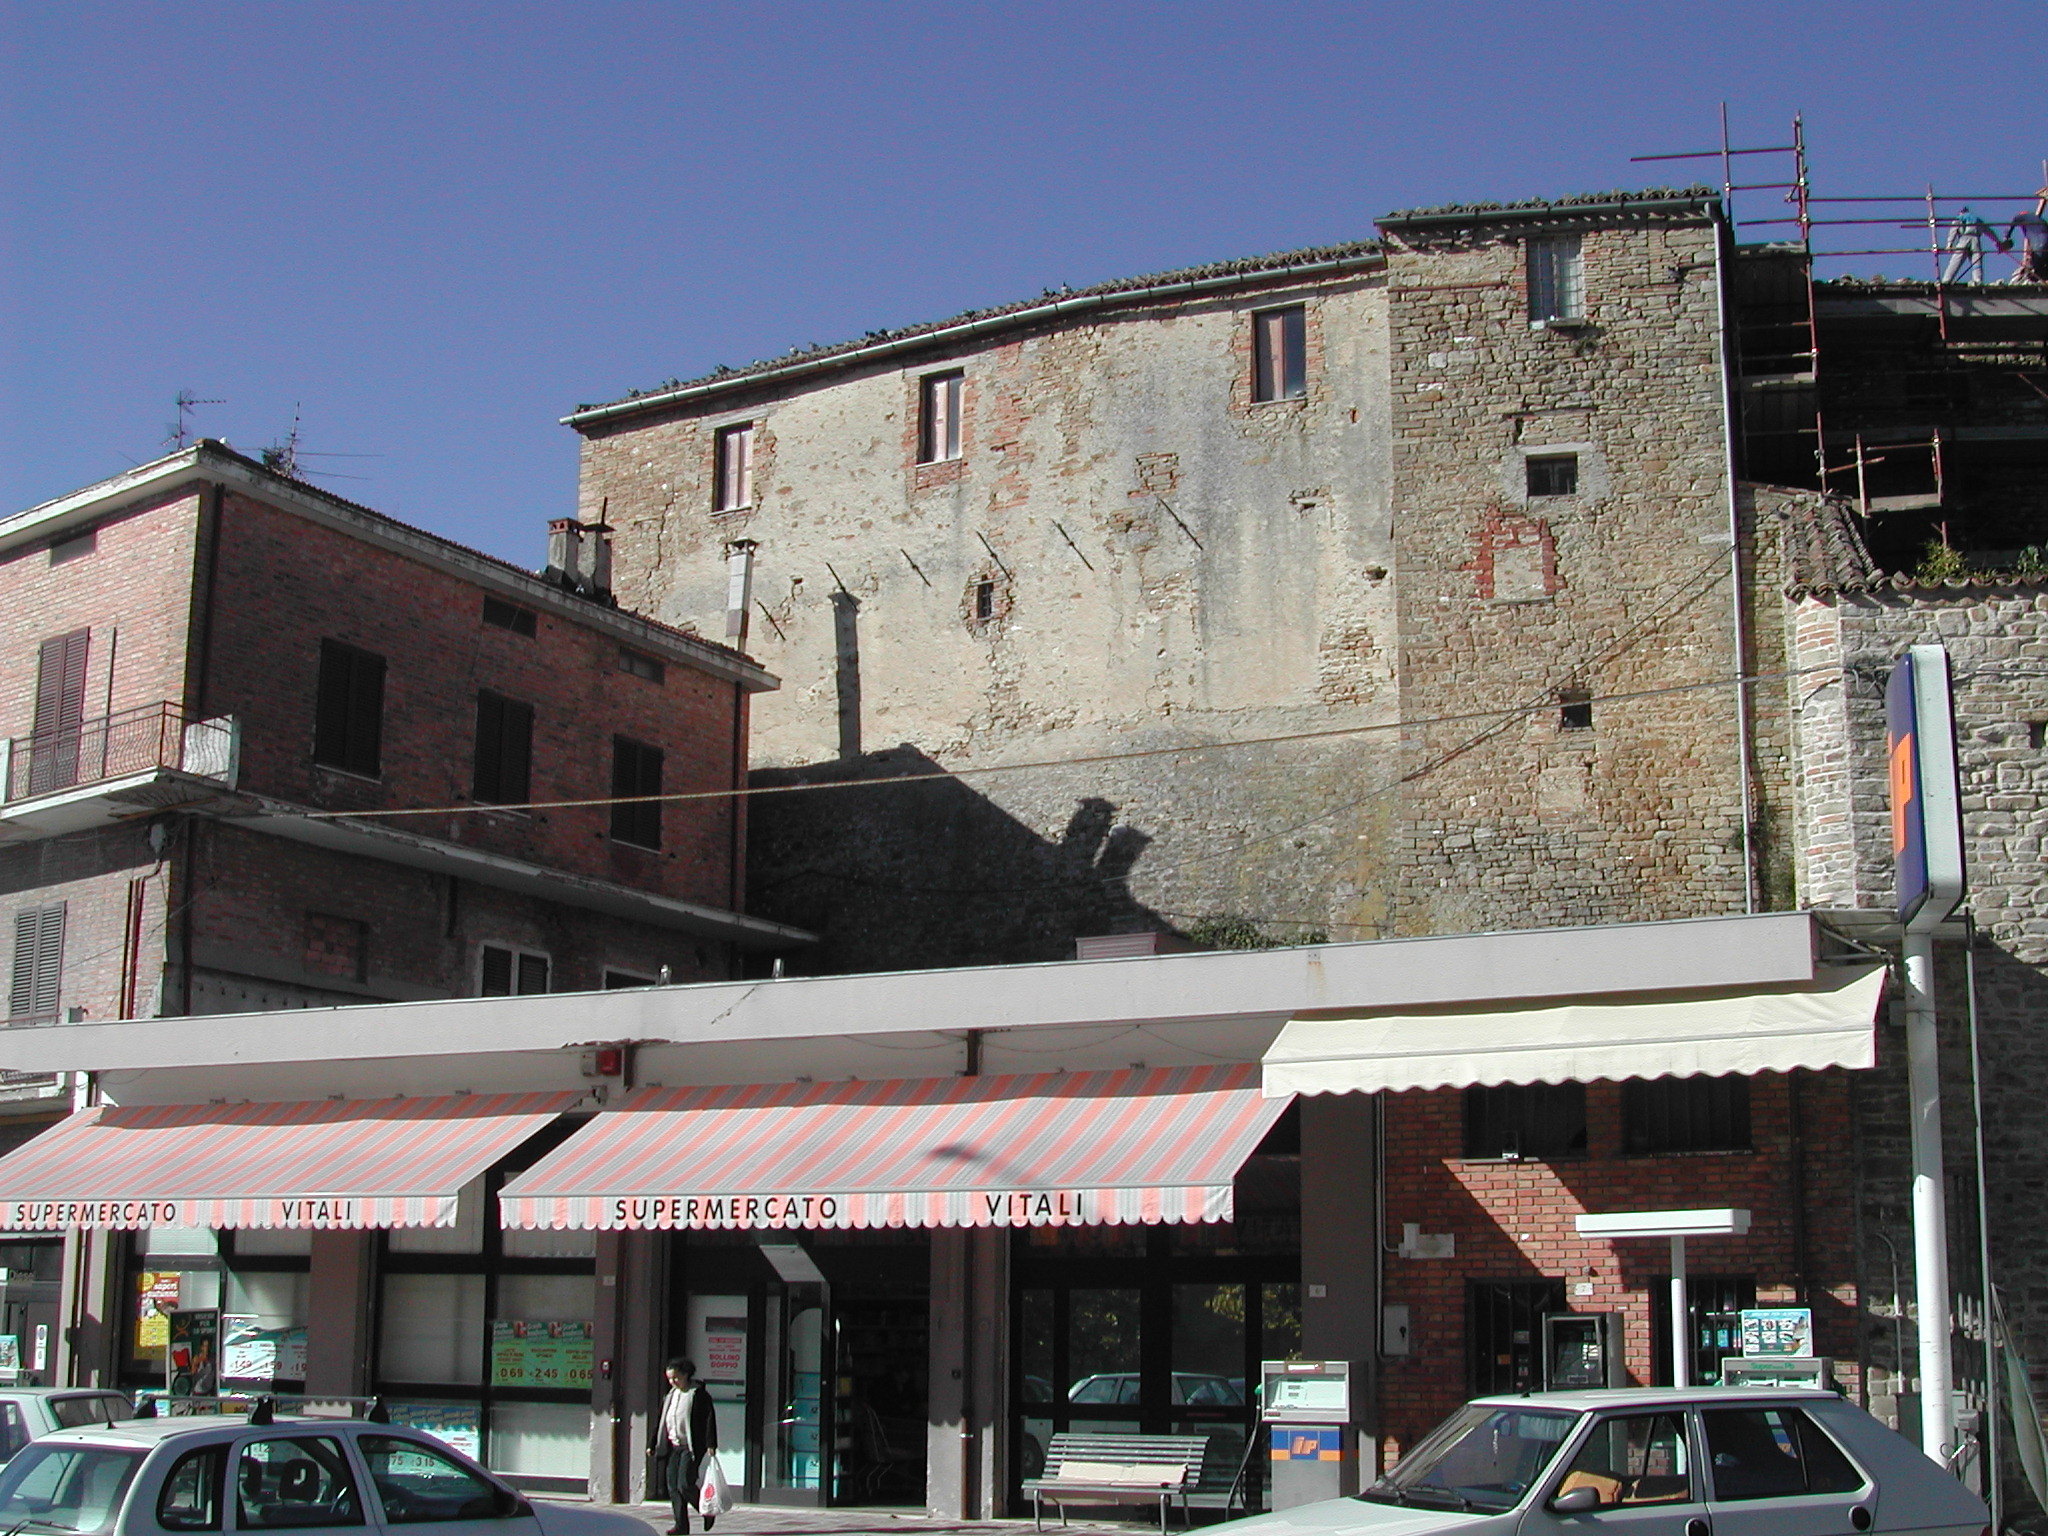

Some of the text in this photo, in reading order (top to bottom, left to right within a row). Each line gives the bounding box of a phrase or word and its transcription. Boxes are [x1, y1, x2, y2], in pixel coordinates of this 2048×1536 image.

[16, 1201, 352, 1222] SUPERMERCATO VITALI
[615, 1193, 1082, 1220] SUPERMERCATO VITALI
